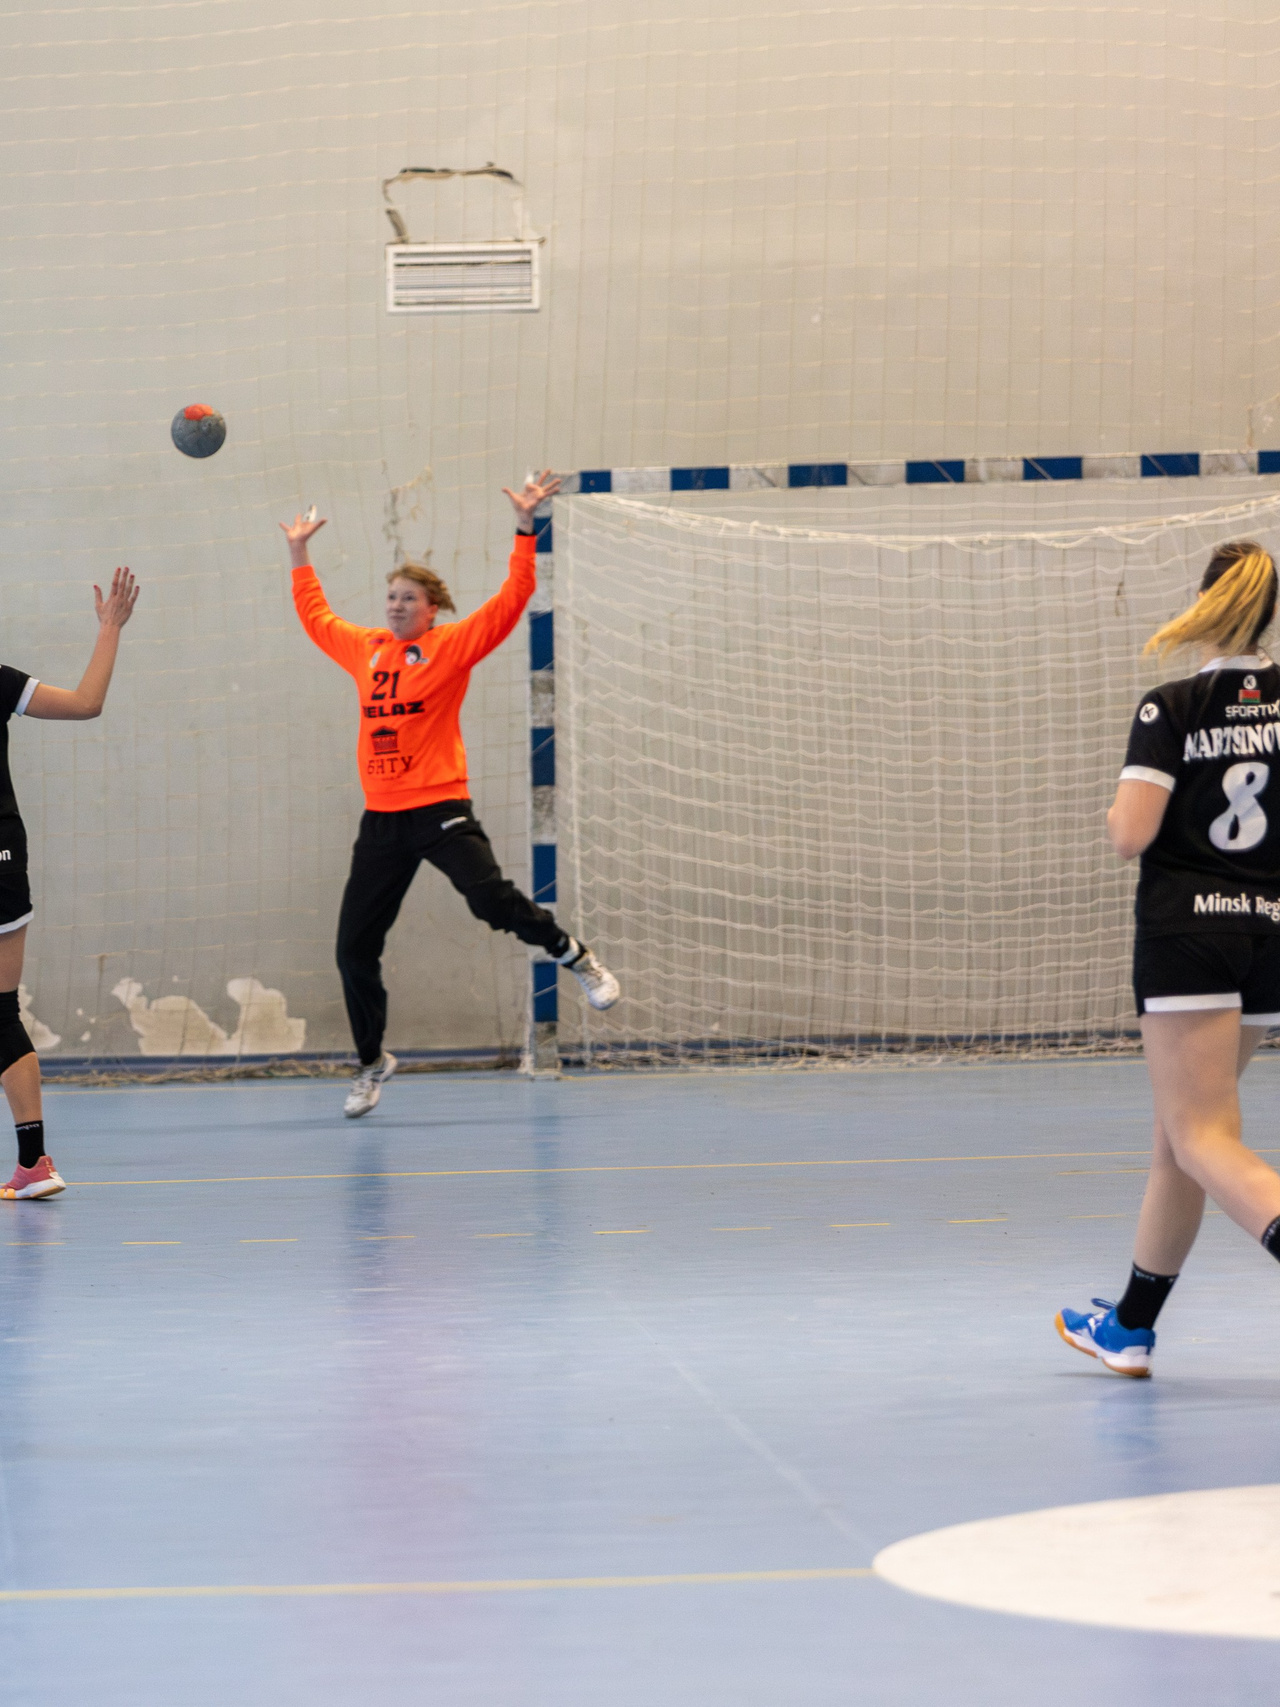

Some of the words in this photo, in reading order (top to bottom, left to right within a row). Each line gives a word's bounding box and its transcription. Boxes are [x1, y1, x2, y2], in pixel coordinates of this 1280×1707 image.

[371, 670, 401, 701] 21
[1208, 761, 1270, 851] 8
[1193, 891, 1252, 915] Minsk
[1255, 896, 1280, 923] Reg
